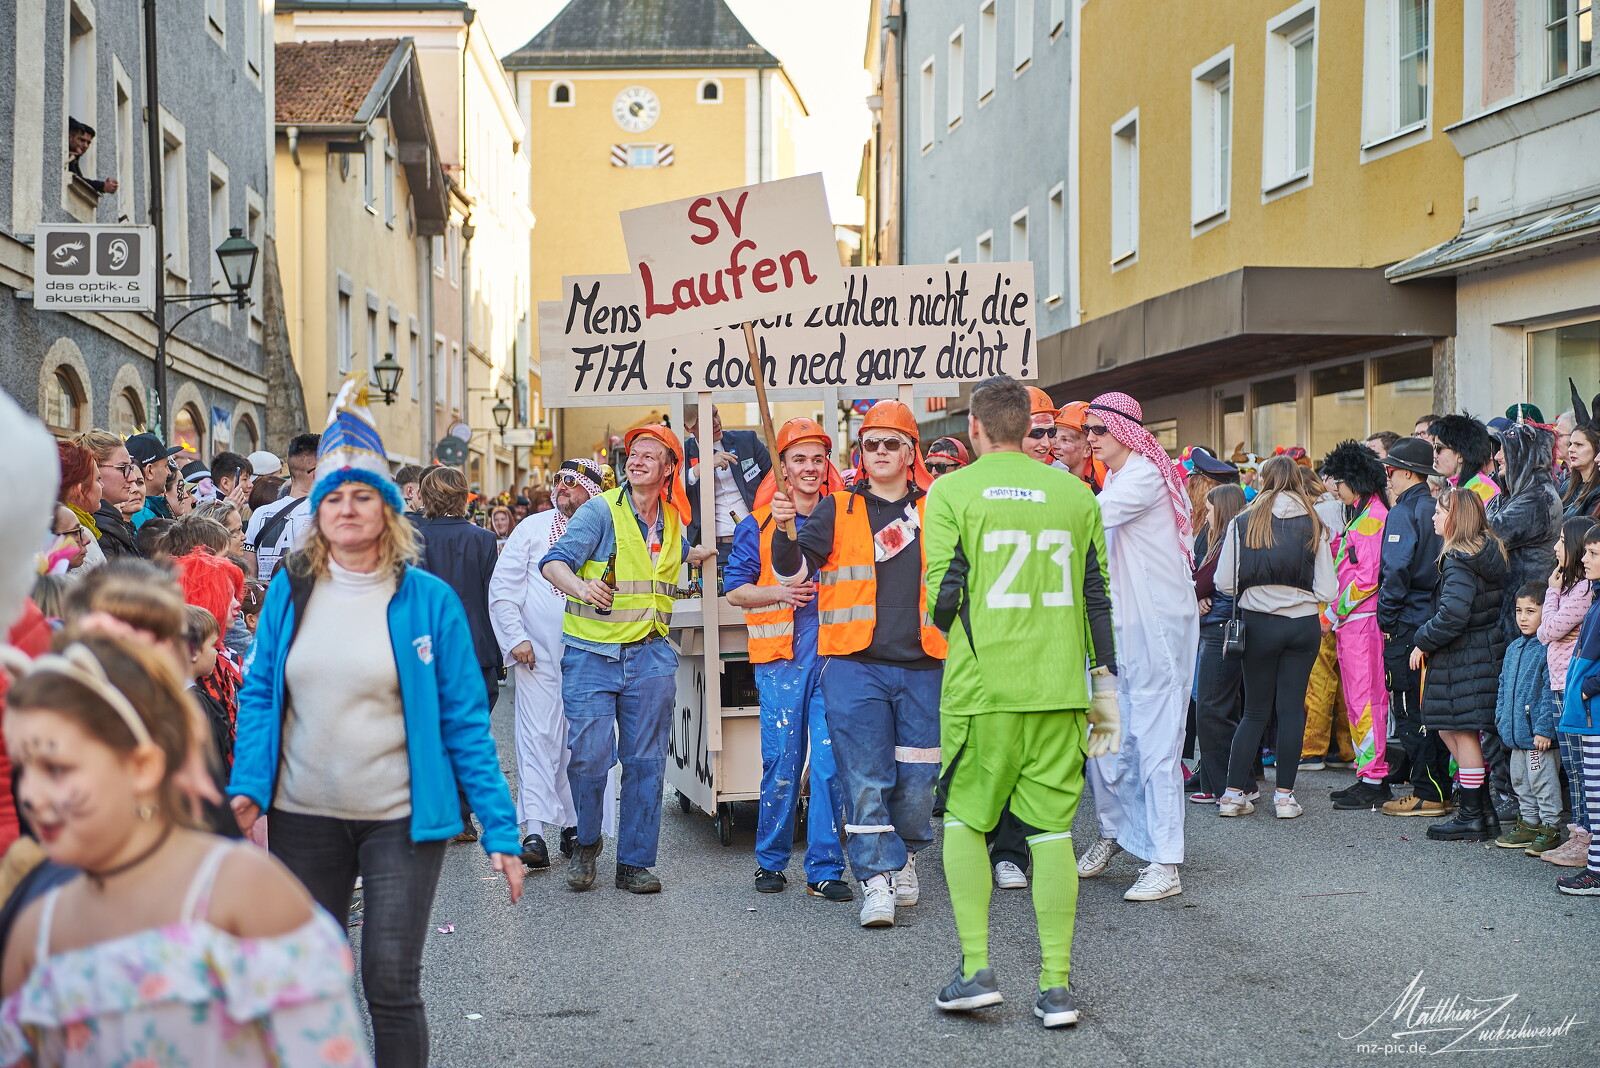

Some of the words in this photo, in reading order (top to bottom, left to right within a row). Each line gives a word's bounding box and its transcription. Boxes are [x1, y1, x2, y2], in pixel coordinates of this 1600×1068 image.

[688, 192, 749, 245] SV
[46, 280, 74, 291] das
[79, 280, 122, 292] optik-
[127, 281, 141, 291] &
[46, 294, 140, 303] akustikhaus
[565, 281, 642, 334] Mens
[908, 270, 977, 334] nicht,
[982, 272, 1028, 326] die
[638, 239, 818, 319] Laufen
[572, 339, 648, 392] FIFA
[665, 348, 693, 389] is
[705, 336, 777, 388] doch
[788, 333, 847, 386] ned
[856, 345, 927, 386] ganz
[936, 330, 1008, 378] dicht
[983, 529, 1075, 609] 23
[1529, 748, 1541, 770] ARTS
